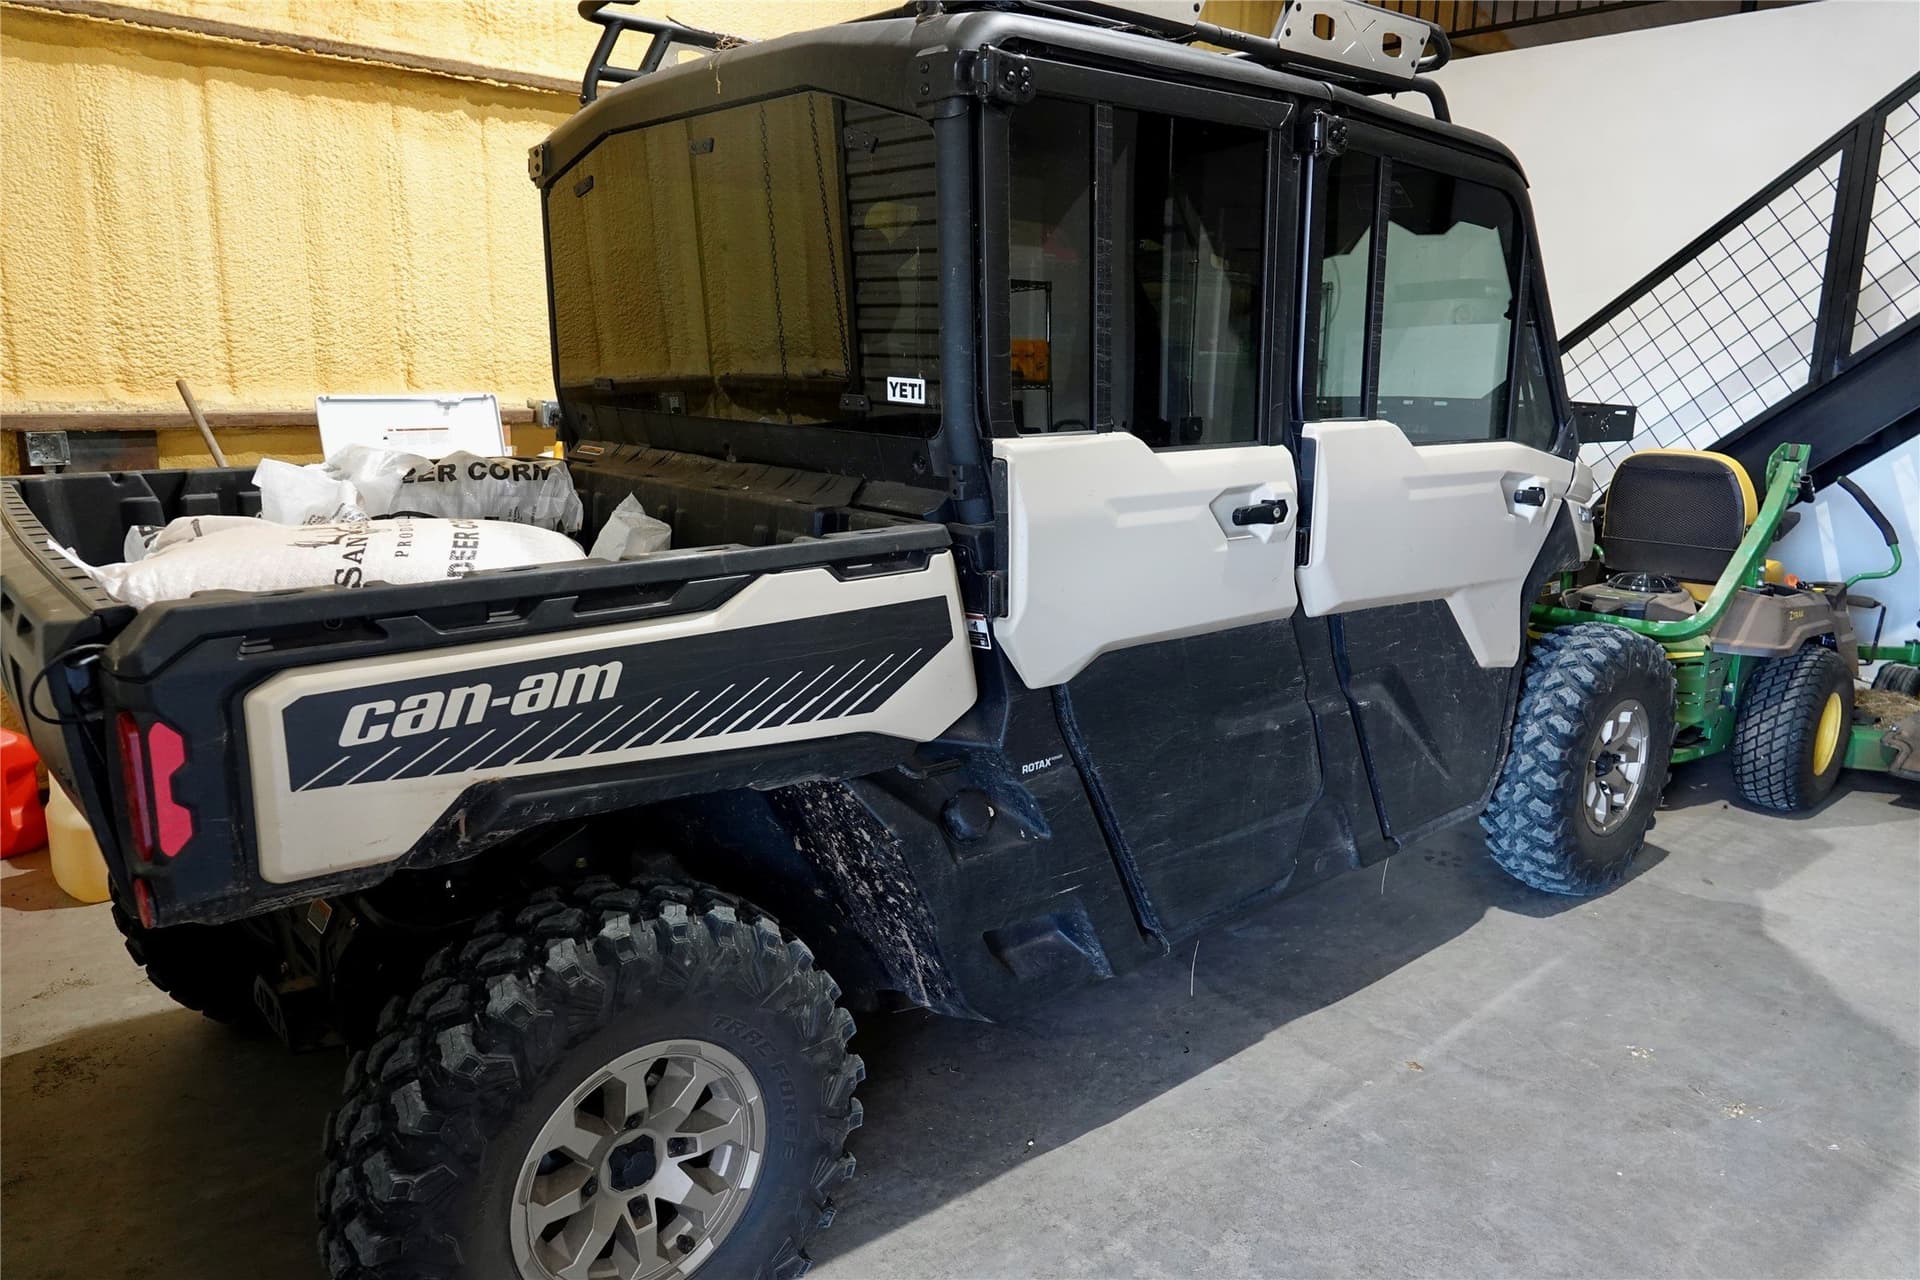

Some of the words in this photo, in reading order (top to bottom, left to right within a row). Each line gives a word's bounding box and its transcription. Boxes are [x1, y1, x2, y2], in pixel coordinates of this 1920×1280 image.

[889, 381, 922, 400] YETI
[338, 660, 623, 747] can-am
[1022, 758, 1052, 775] ROTAX
